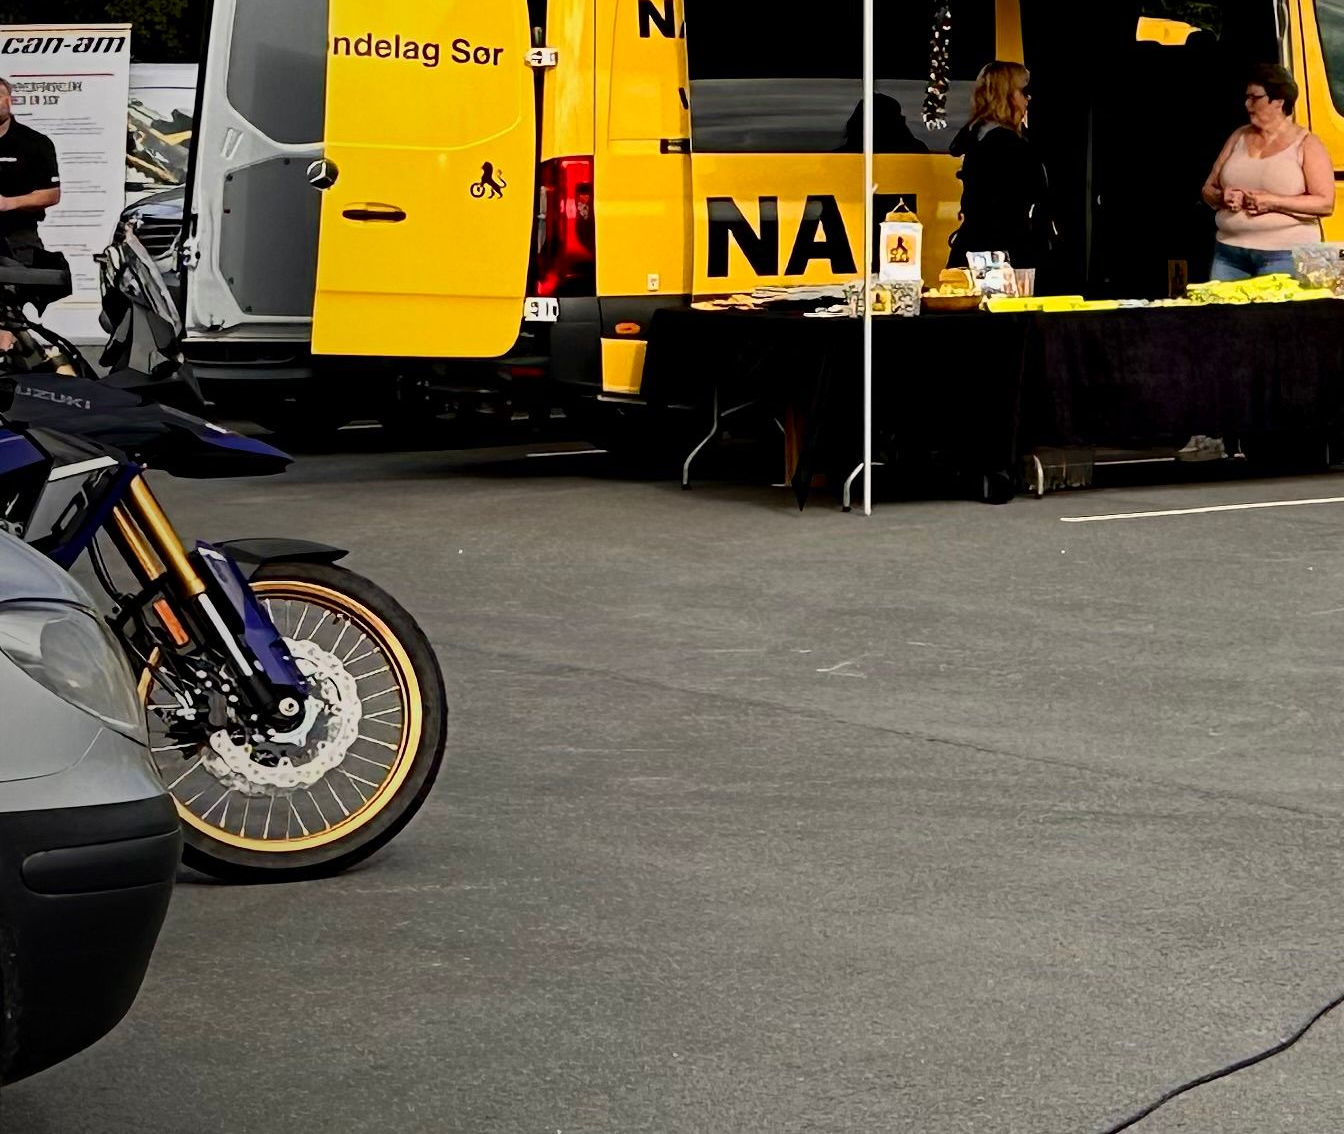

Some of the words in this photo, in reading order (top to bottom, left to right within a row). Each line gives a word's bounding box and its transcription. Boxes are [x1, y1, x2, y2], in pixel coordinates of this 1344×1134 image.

[1, 37, 126, 54] can-am
[452, 38, 504, 66] Sør
[15, 385, 91, 410] UZUKI
